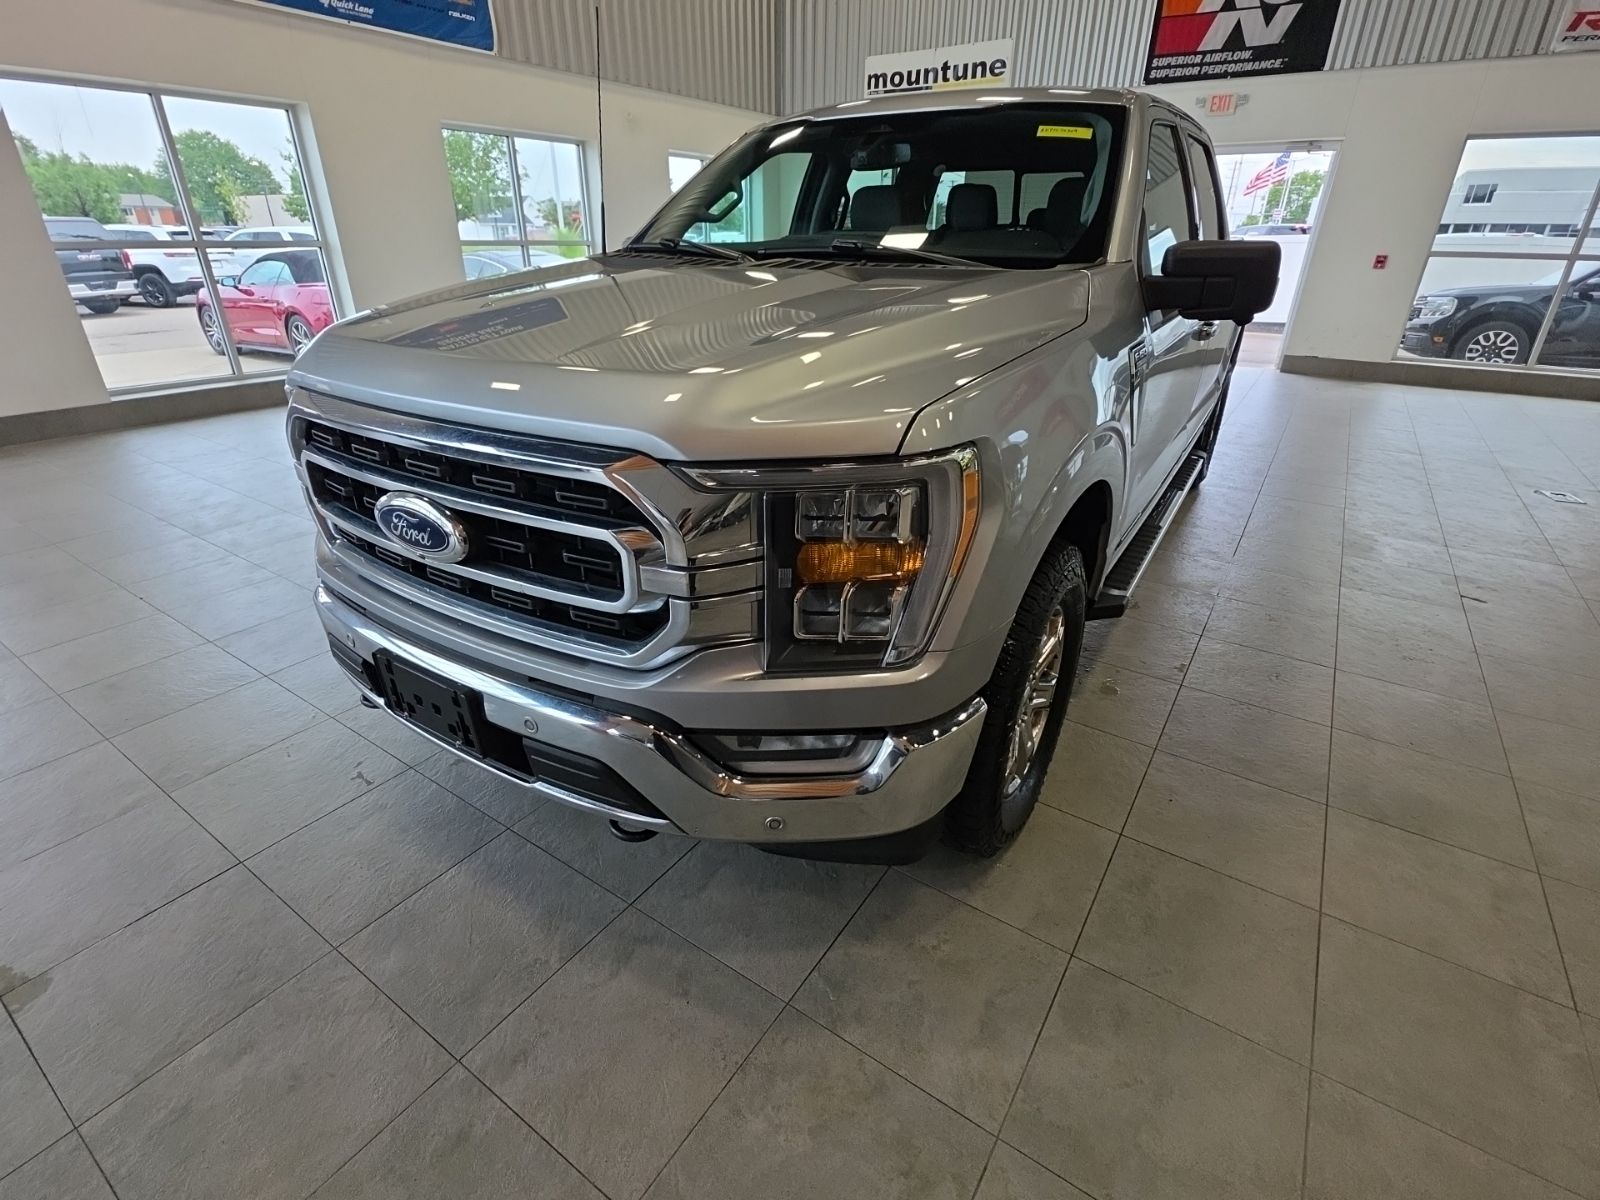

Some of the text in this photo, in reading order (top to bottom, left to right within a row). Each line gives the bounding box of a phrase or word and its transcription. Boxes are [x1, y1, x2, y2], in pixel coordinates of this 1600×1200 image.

[1151, 50, 1253, 67] SUPERIOR AIRFLOW.
[867, 58, 1007, 90] mountune
[1149, 66, 1200, 79] SUPERIOR
[1209, 95, 1234, 112] EXIT
[390, 511, 432, 546] Ford
